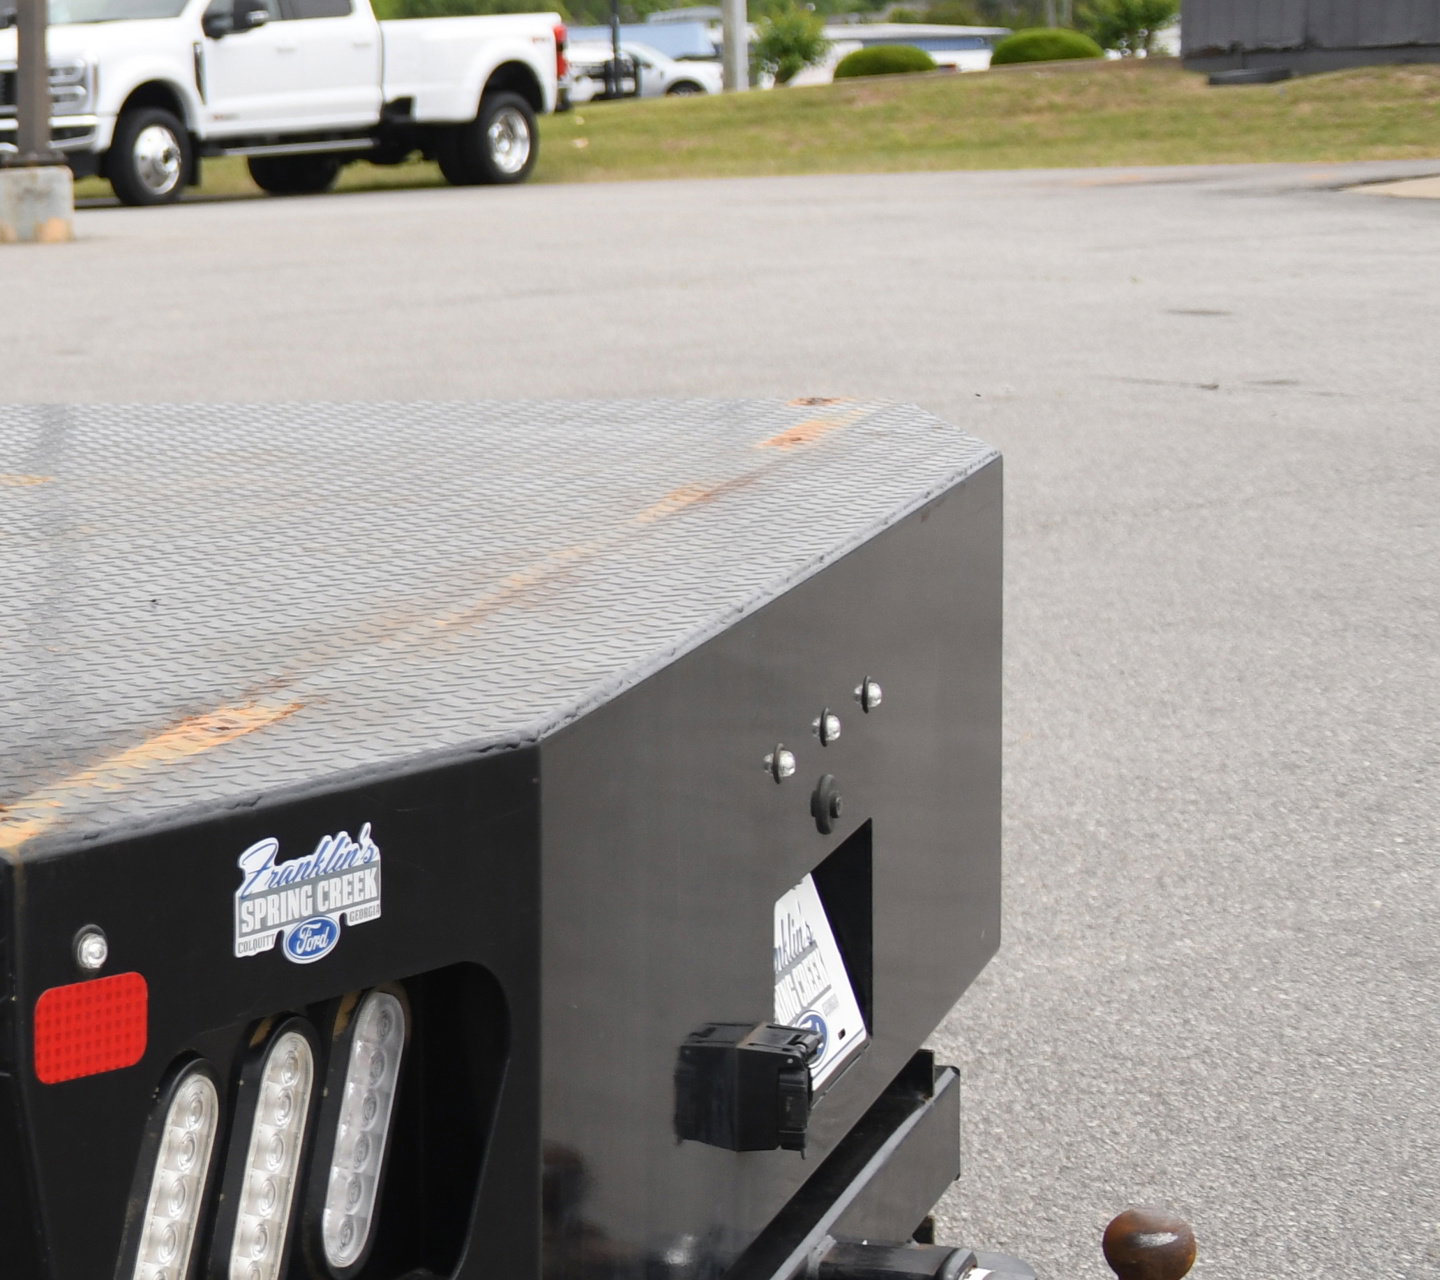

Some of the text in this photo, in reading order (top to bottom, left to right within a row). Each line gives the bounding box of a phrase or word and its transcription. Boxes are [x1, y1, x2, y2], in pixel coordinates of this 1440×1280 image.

[240, 826, 377, 900] Franklin's
[238, 904, 380, 954] COLQUITT GEORGIA
[241, 867, 378, 933] SPRING CREEK
[296, 922, 330, 955] Ford
